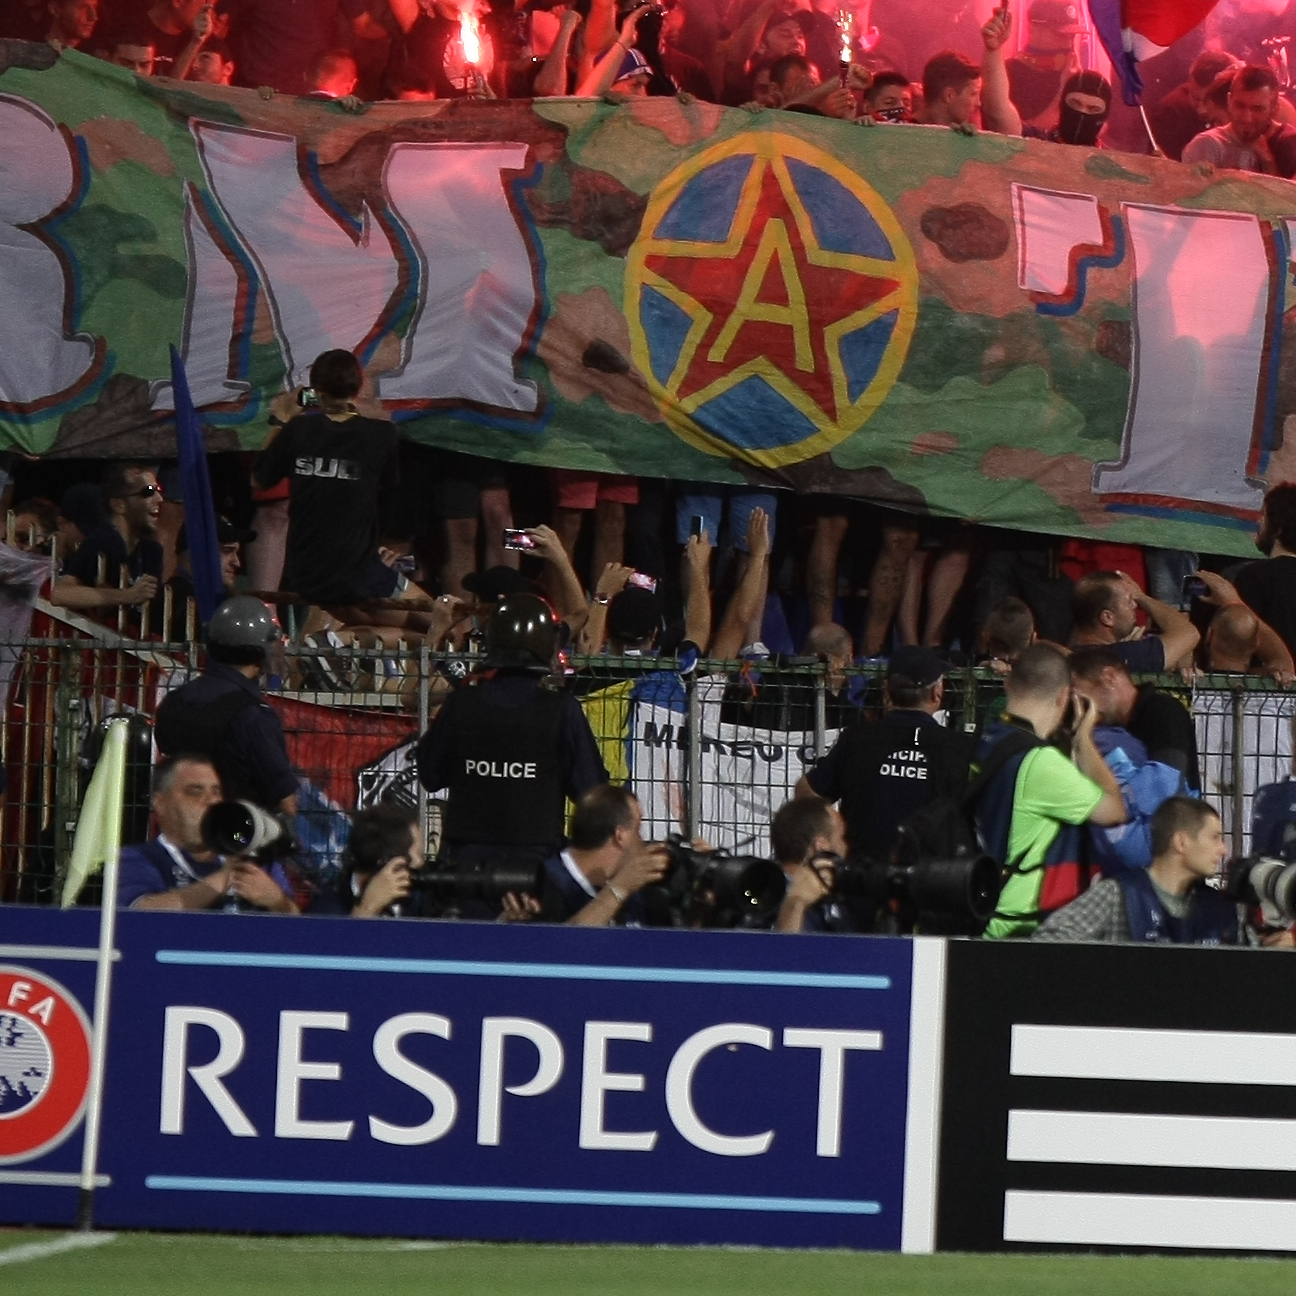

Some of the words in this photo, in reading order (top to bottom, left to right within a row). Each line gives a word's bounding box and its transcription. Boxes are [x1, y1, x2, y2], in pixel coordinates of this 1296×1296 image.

[464, 758, 538, 780] POLICE
[879, 763, 928, 781] OLICE
[158, 1004, 884, 1158] RESPECT
